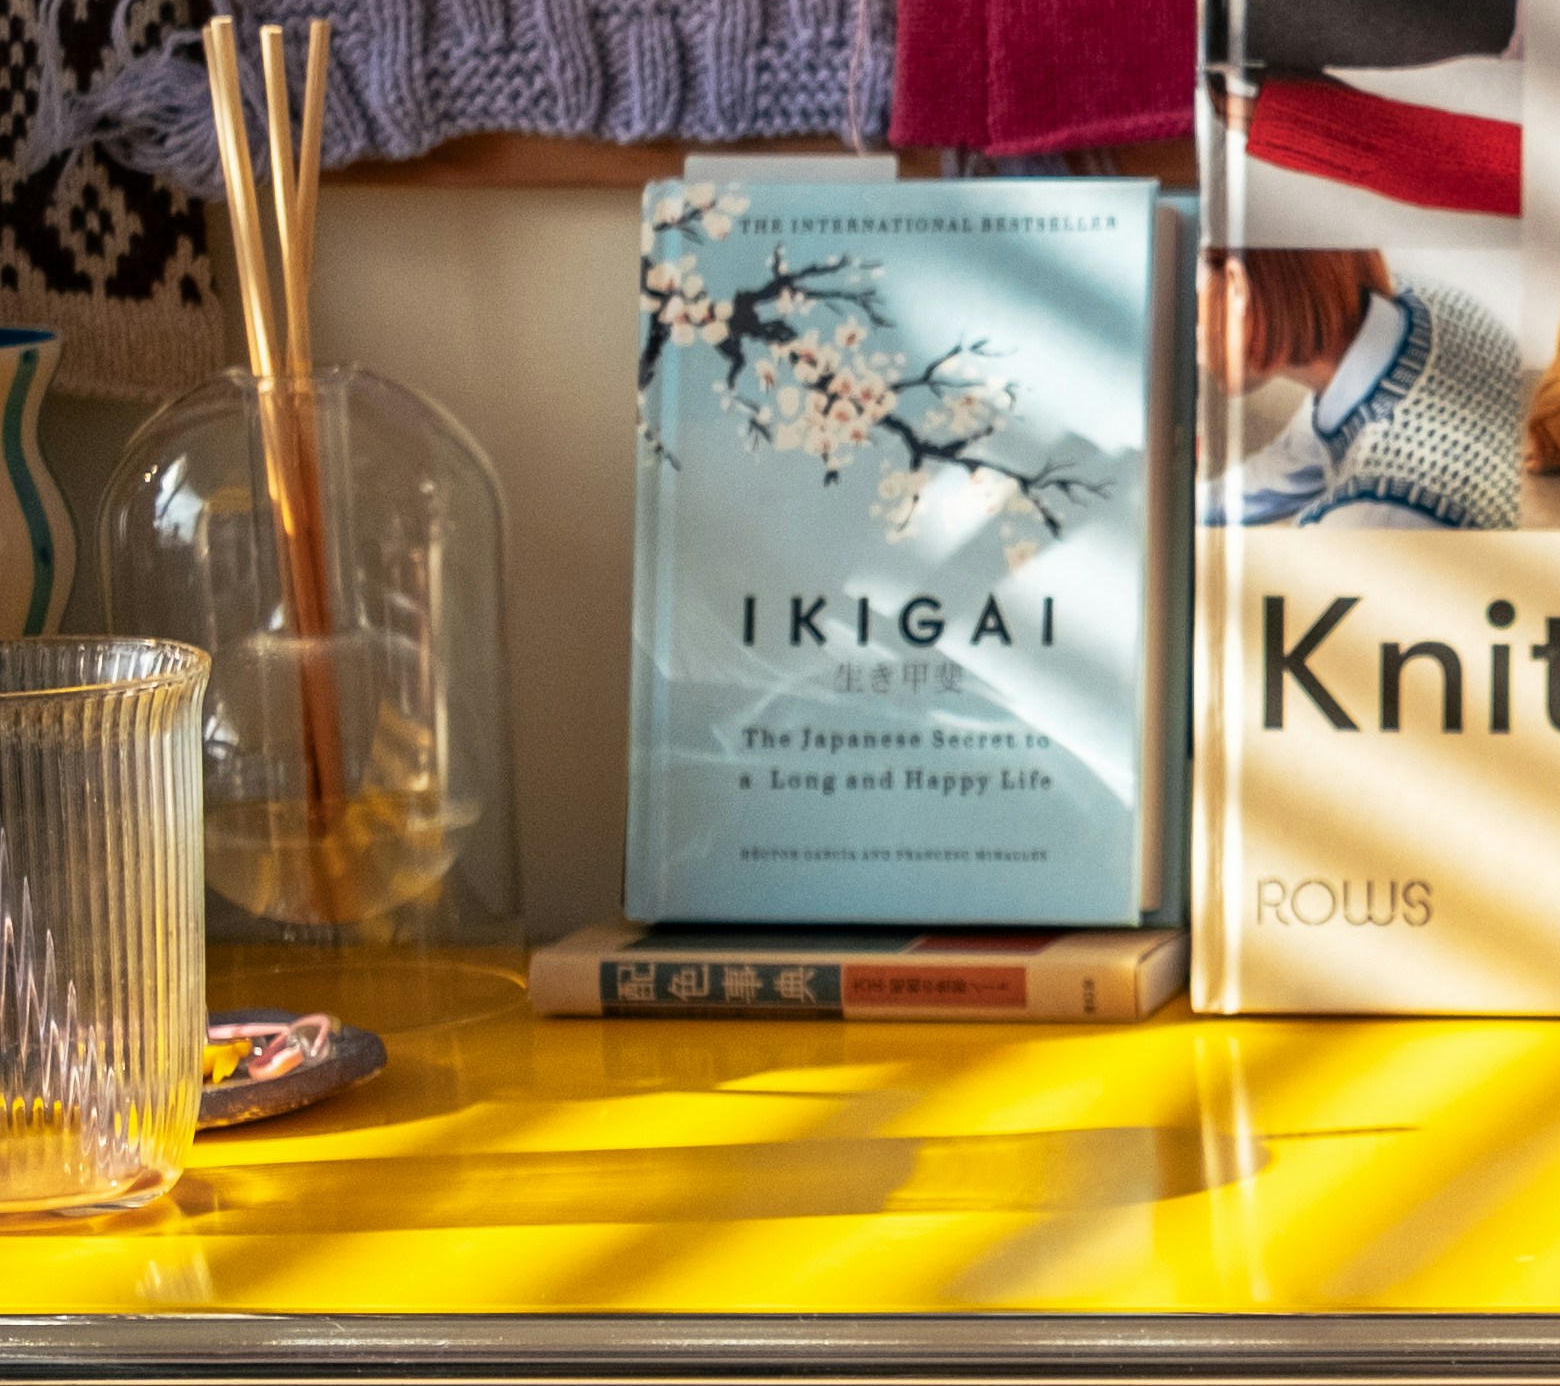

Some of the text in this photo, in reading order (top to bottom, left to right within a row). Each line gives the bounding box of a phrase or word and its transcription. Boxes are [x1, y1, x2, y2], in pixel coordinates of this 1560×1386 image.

[739, 215, 1119, 235] THE INTERNATIONAL BESTSELLER
[742, 591, 1055, 647] IKIGAI
[833, 661, 966, 695] 生き甲斐
[741, 728, 1051, 755] The Japanese Secret to
[738, 769, 1055, 797] a Long and Happy Life
[1256, 878, 1435, 928] ROWS
[616, 962, 819, 1005] 配色事典
